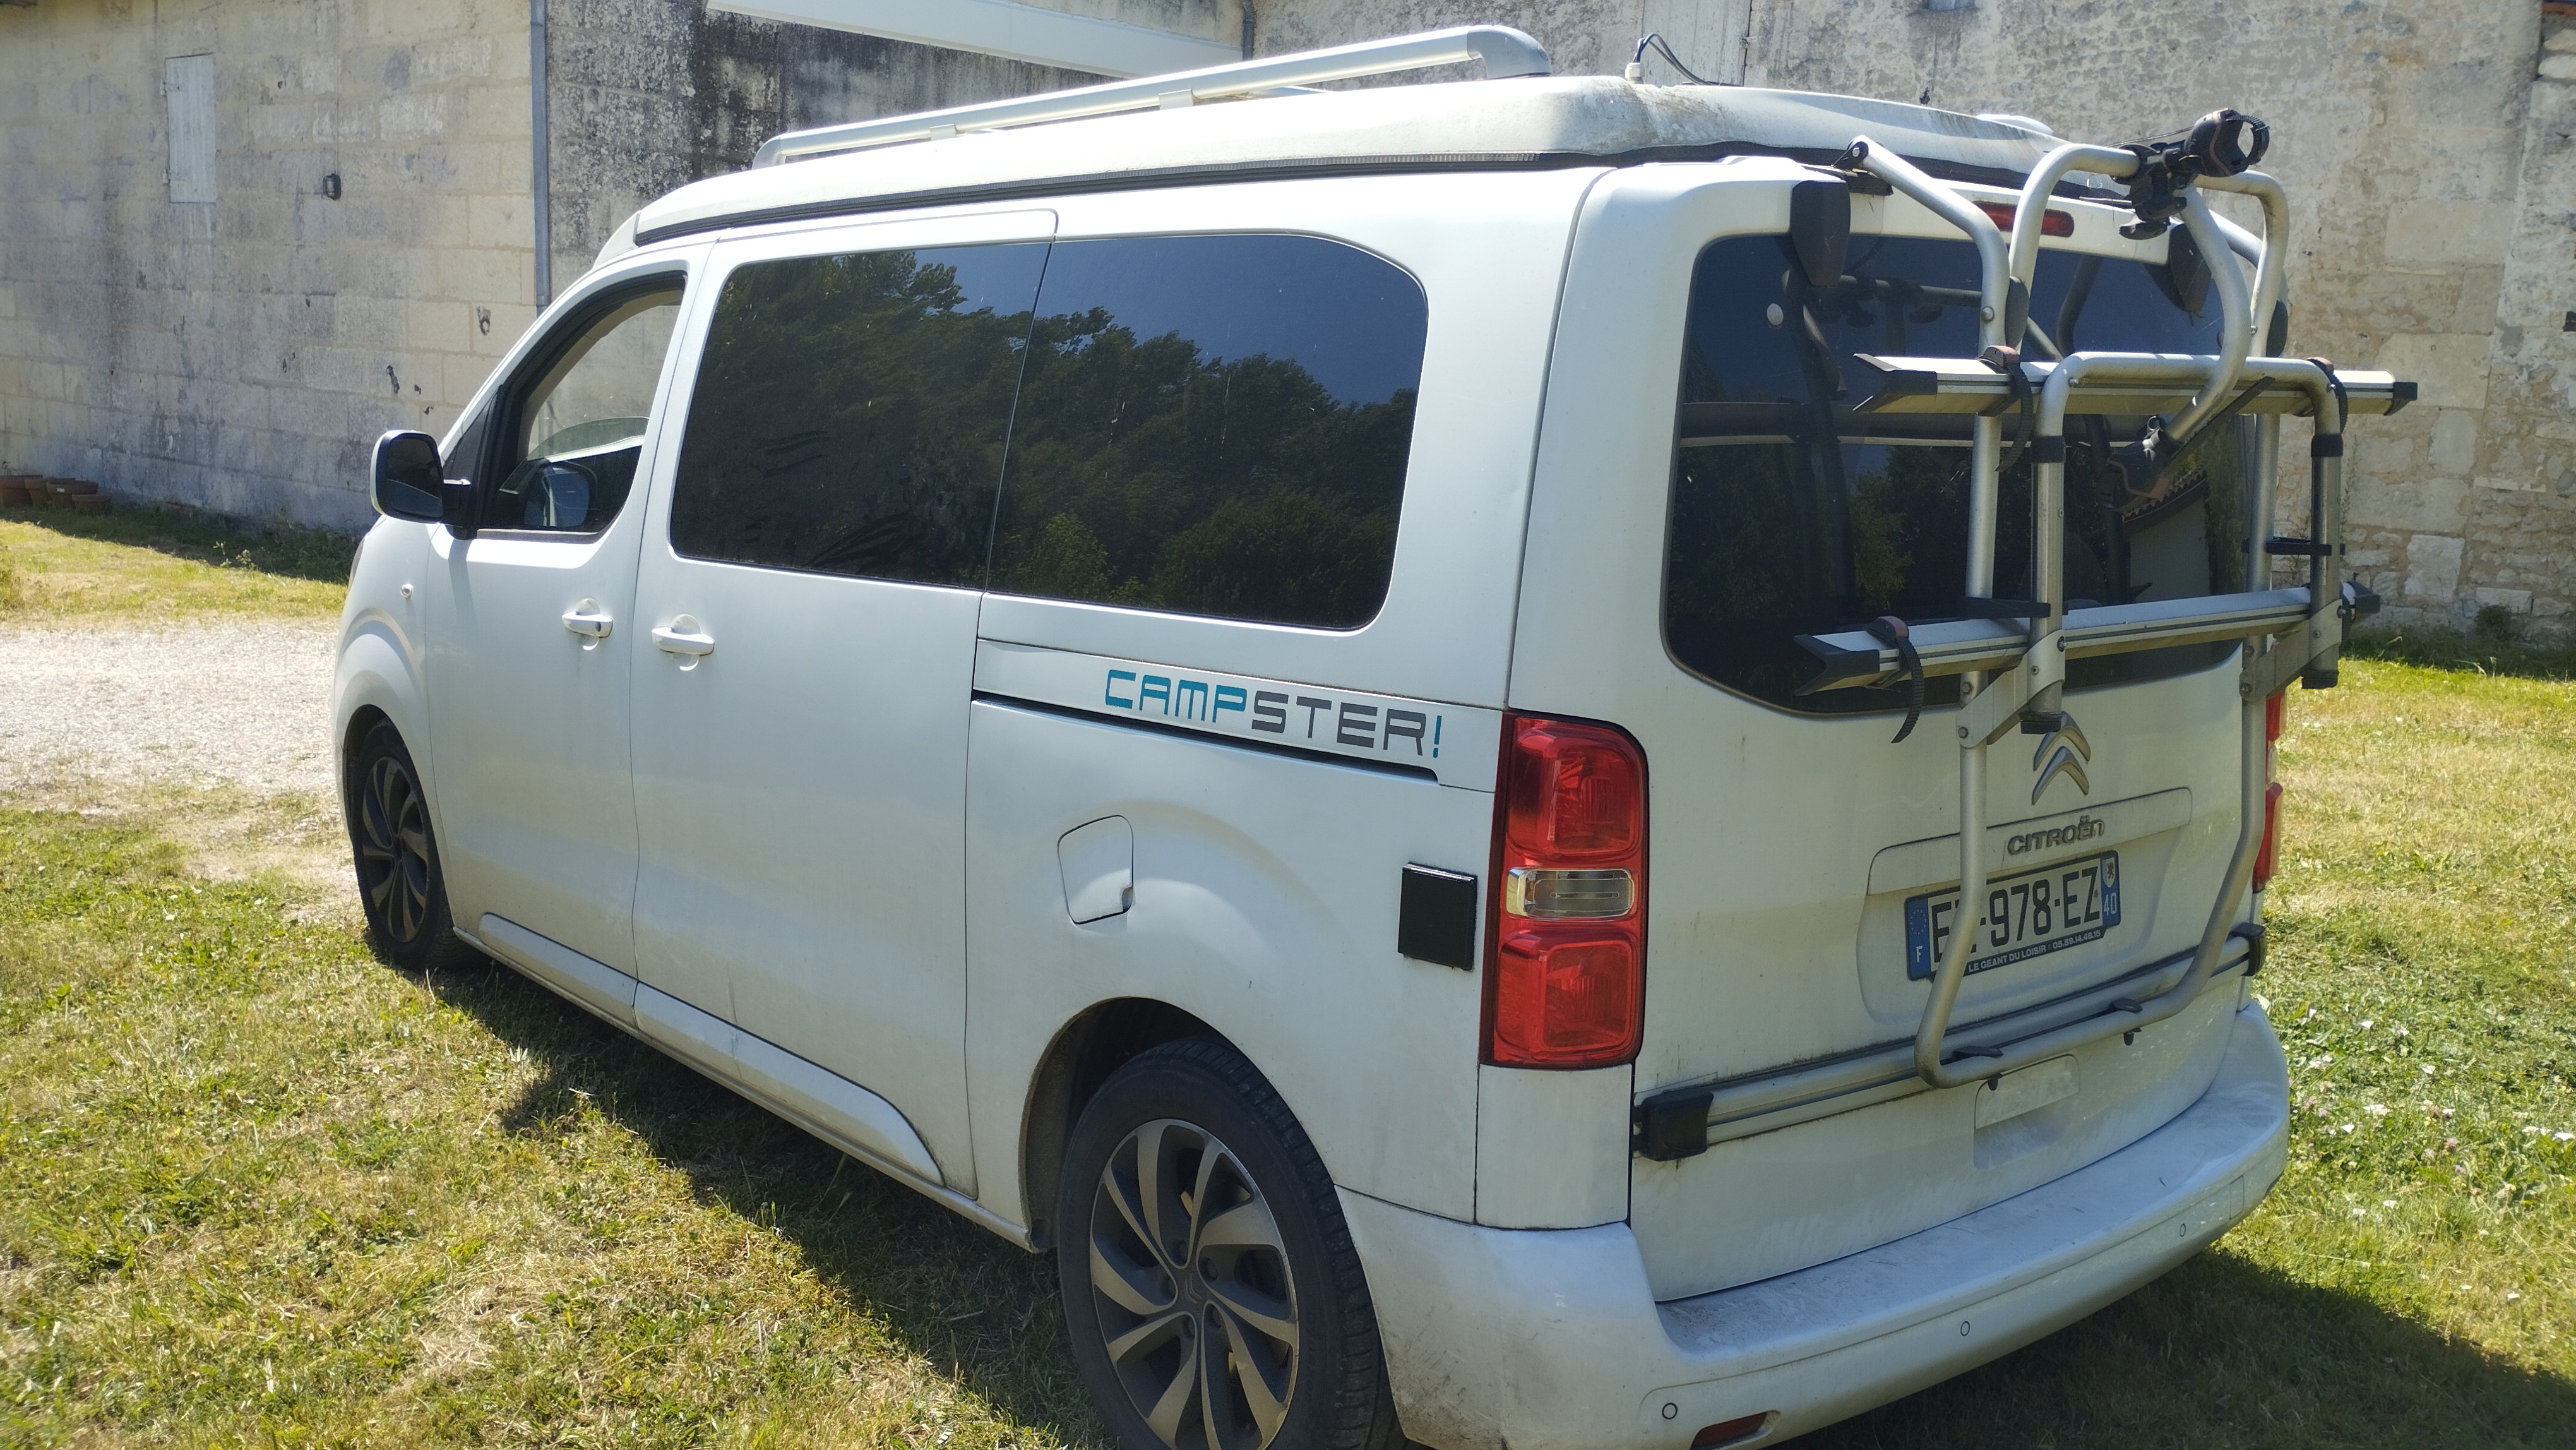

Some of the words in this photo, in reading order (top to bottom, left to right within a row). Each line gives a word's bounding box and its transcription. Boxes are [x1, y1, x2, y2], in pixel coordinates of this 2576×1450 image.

[1106, 669, 1442, 758] CAMPSTER!
[1931, 866, 2101, 964] E-978-EZ
[2104, 892, 2117, 916] 40
[1916, 945, 1923, 963] F
[1968, 962, 1980, 973] LE
[1980, 954, 2008, 969] GEANT
[2009, 951, 2020, 962] DU
[2022, 945, 2047, 958] LOISIR
